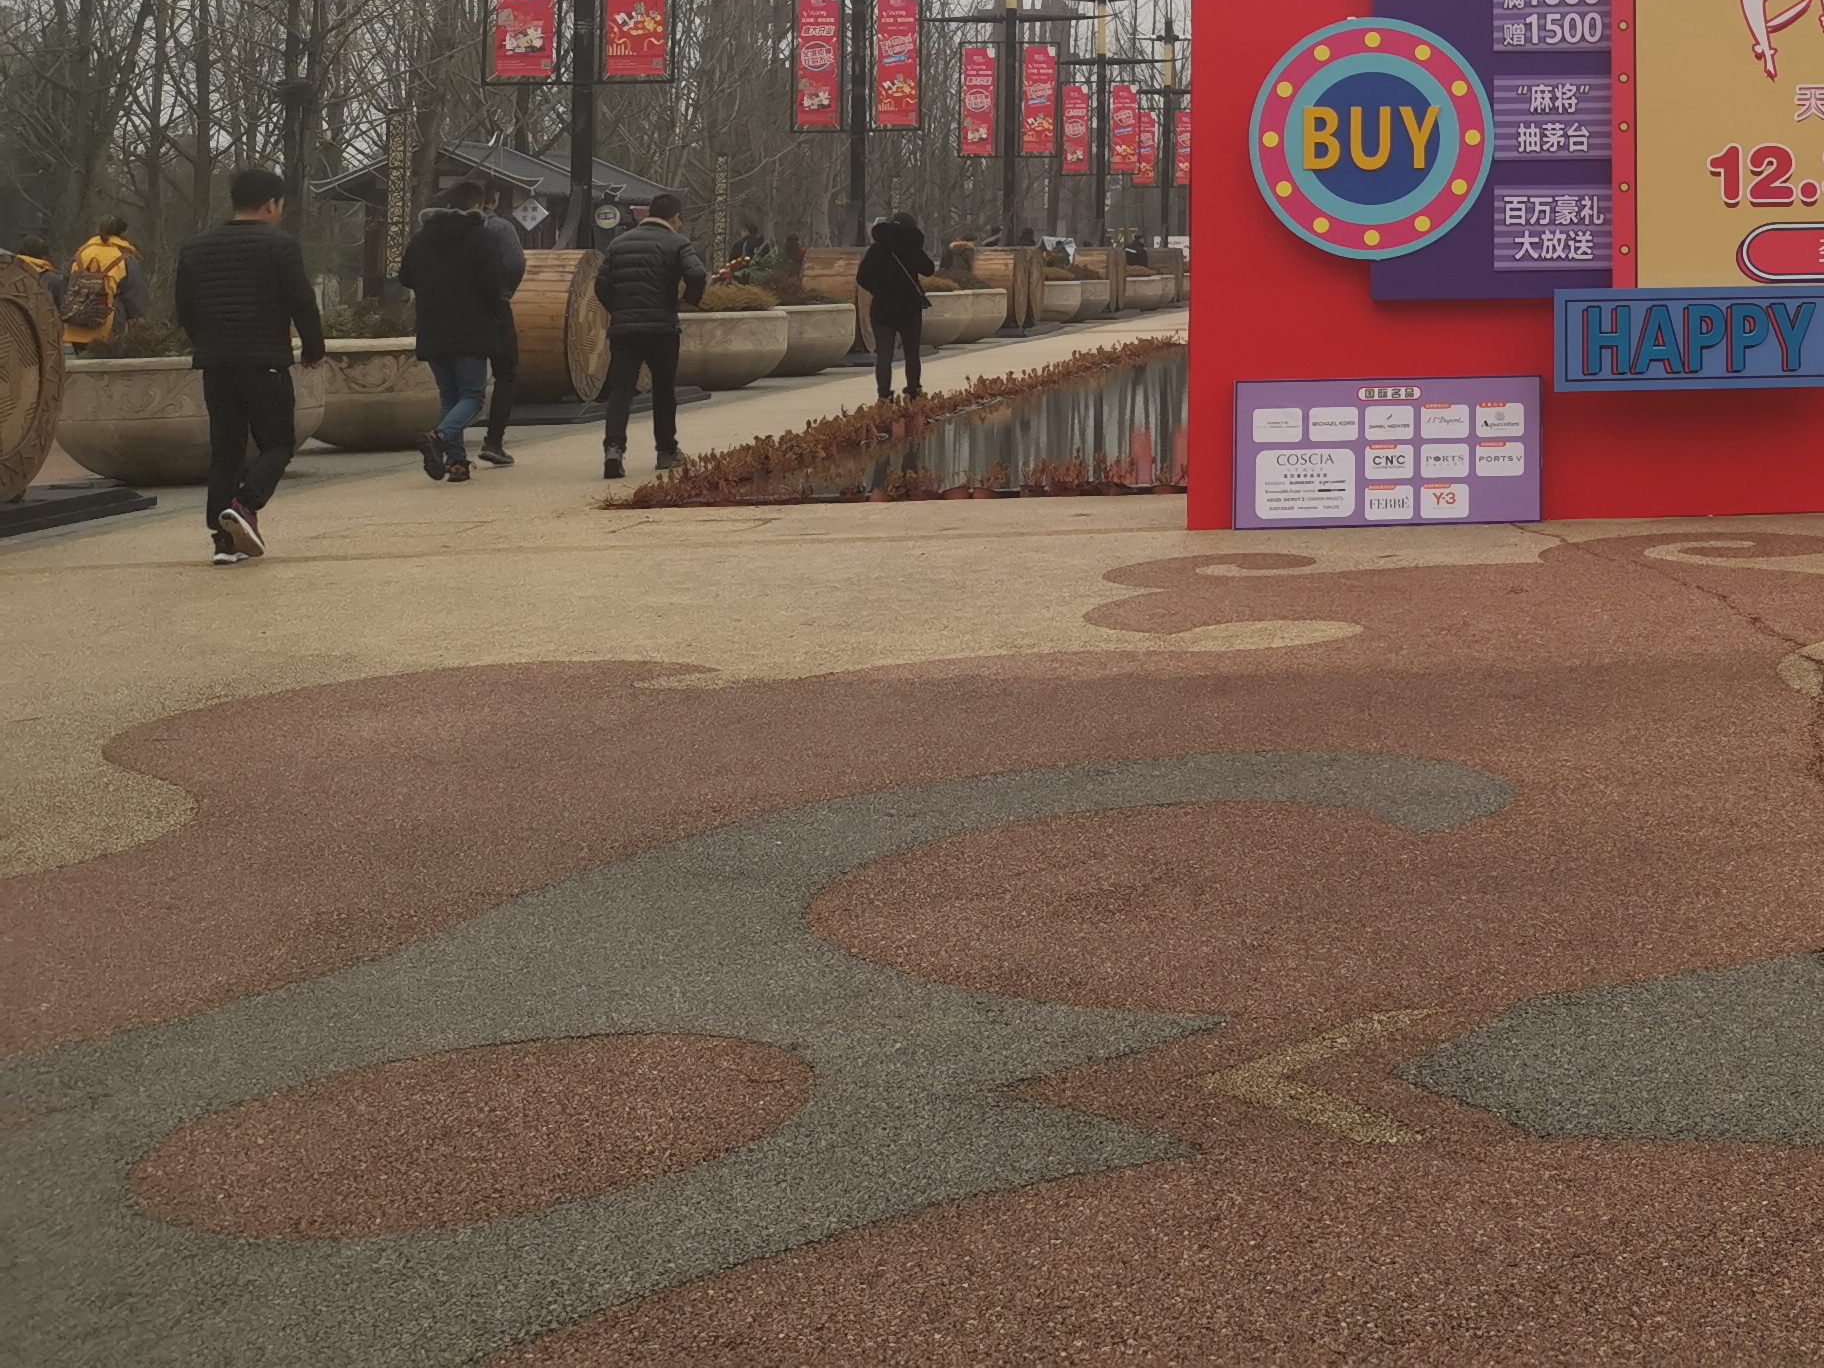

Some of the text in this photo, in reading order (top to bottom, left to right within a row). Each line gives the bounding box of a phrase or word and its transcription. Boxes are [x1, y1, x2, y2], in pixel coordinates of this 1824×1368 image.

[1503, 12, 1603, 47] 赠1500
[1302, 106, 1442, 170] BUY
[1517, 123, 1591, 153] 抽茅台
[1503, 196, 1604, 226] 百万豪礼
[1514, 230, 1594, 260] 大放送
[1582, 302, 1816, 375] HAPPY
[1364, 388, 1415, 399] 国际名品
[1276, 453, 1335, 466] COSCIA
[1478, 455, 1514, 463] PORTS
